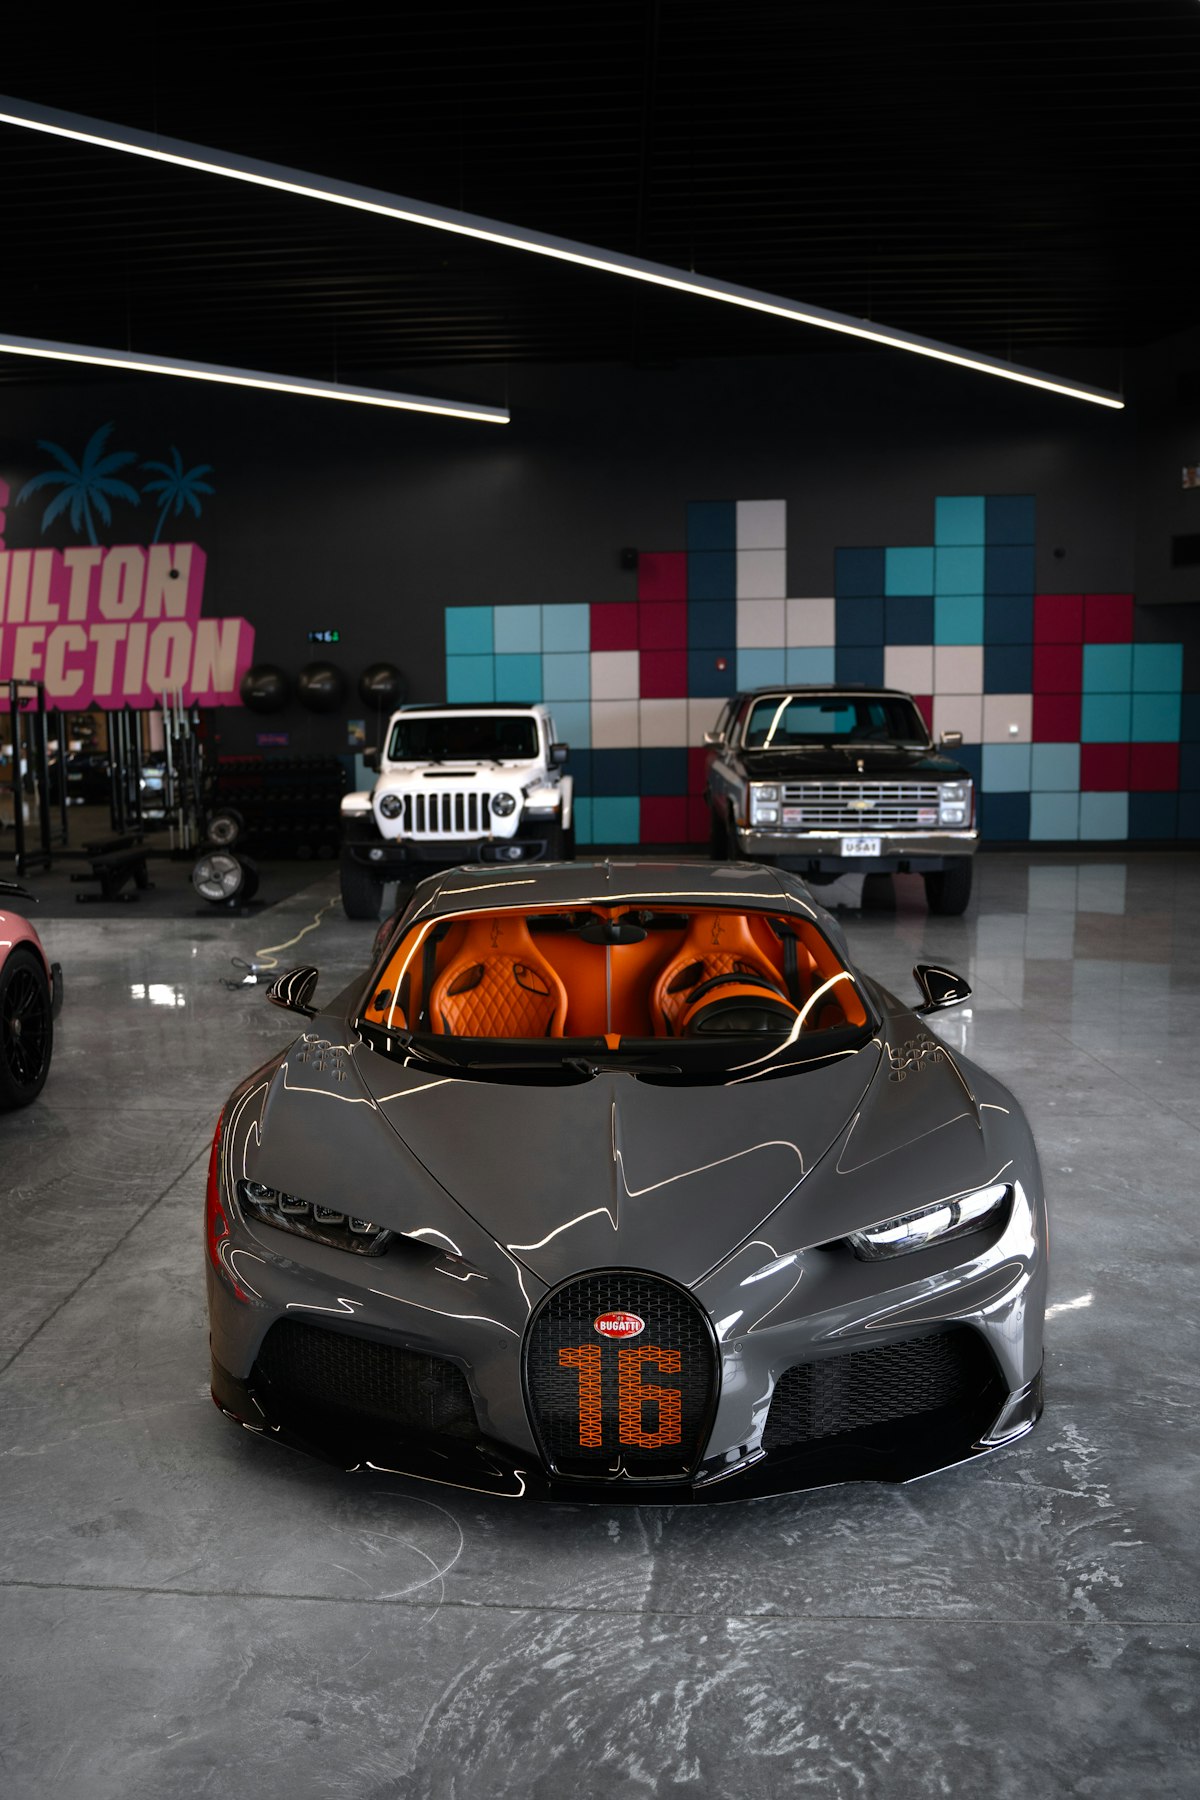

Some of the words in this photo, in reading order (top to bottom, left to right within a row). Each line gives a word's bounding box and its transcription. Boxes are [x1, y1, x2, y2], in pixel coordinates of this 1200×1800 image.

[0, 544, 194, 623] ILTON
[0, 619, 242, 698] ECTION
[600, 1321, 639, 1331] BUGATTI
[558, 1344, 682, 1449] 16
